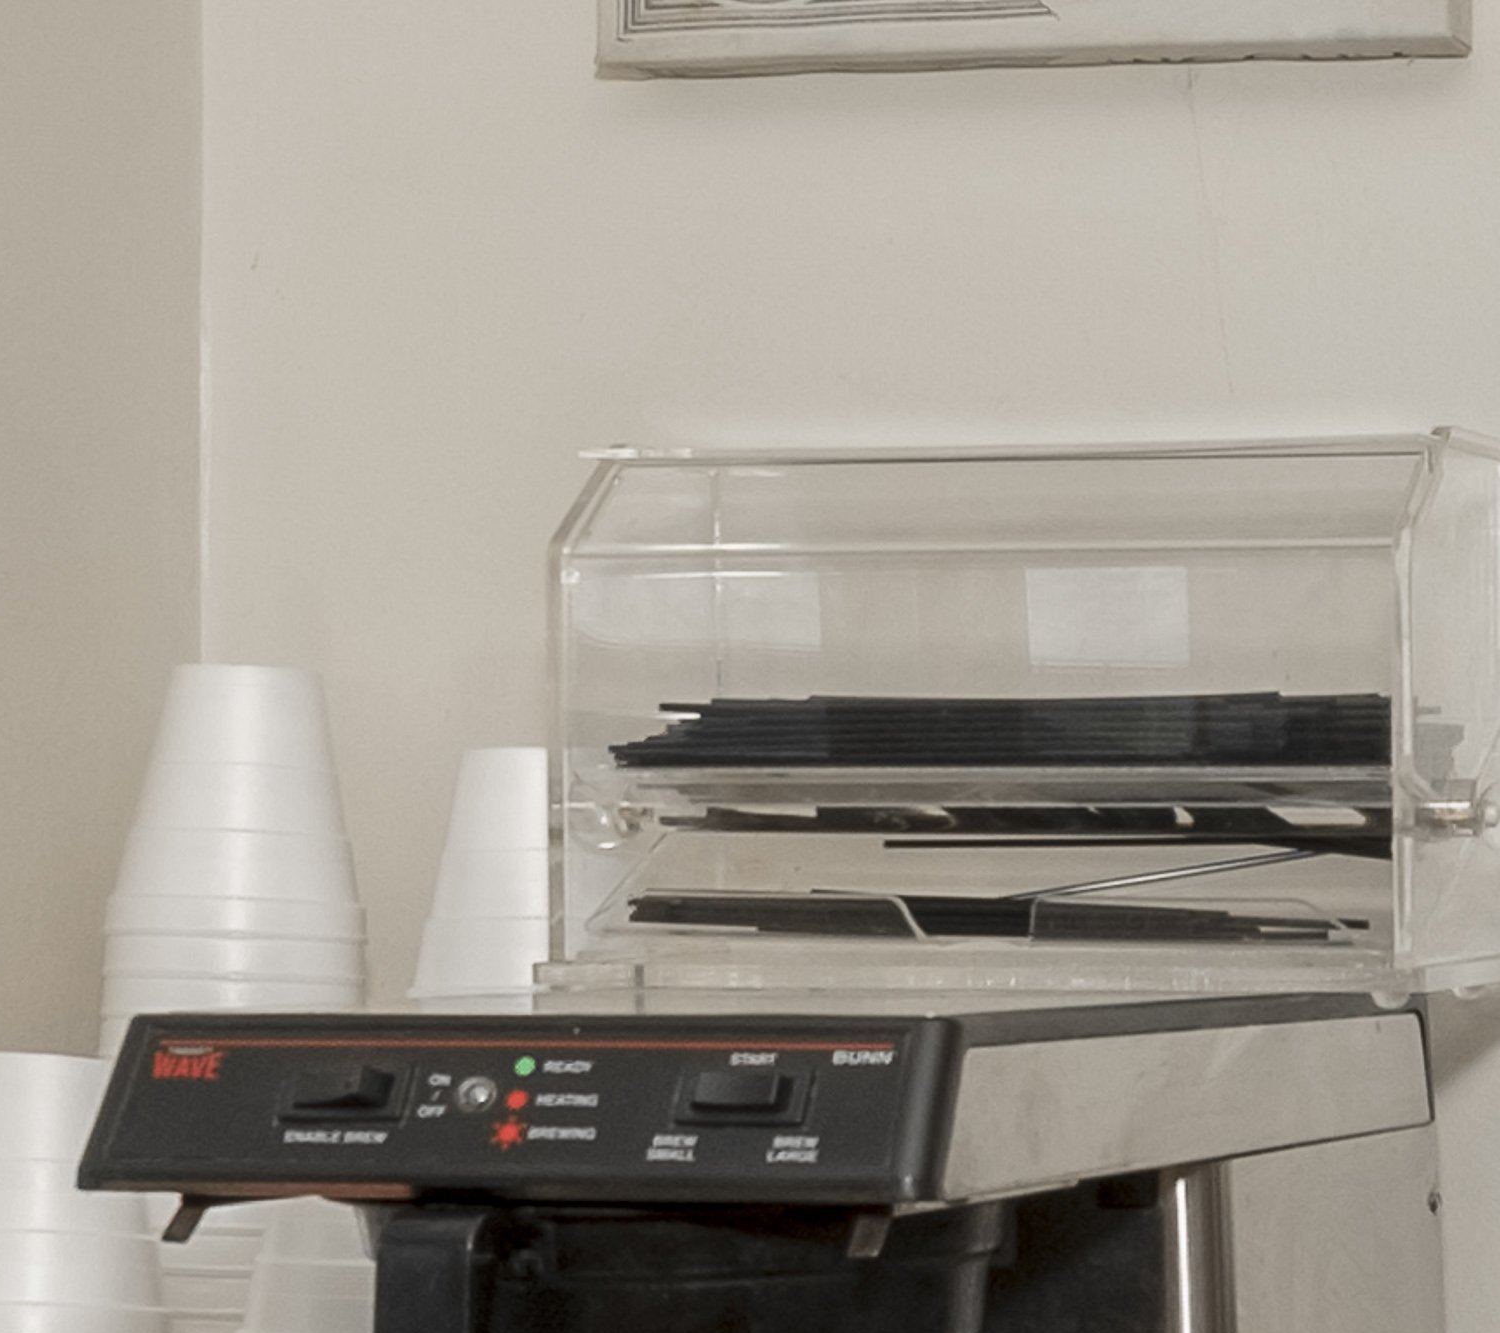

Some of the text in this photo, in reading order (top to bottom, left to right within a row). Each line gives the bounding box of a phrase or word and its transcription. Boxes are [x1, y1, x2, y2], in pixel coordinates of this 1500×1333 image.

[152, 1050, 226, 1080] WAVE
[832, 1050, 894, 1066] BUNN
[417, 1104, 447, 1118] OFF
